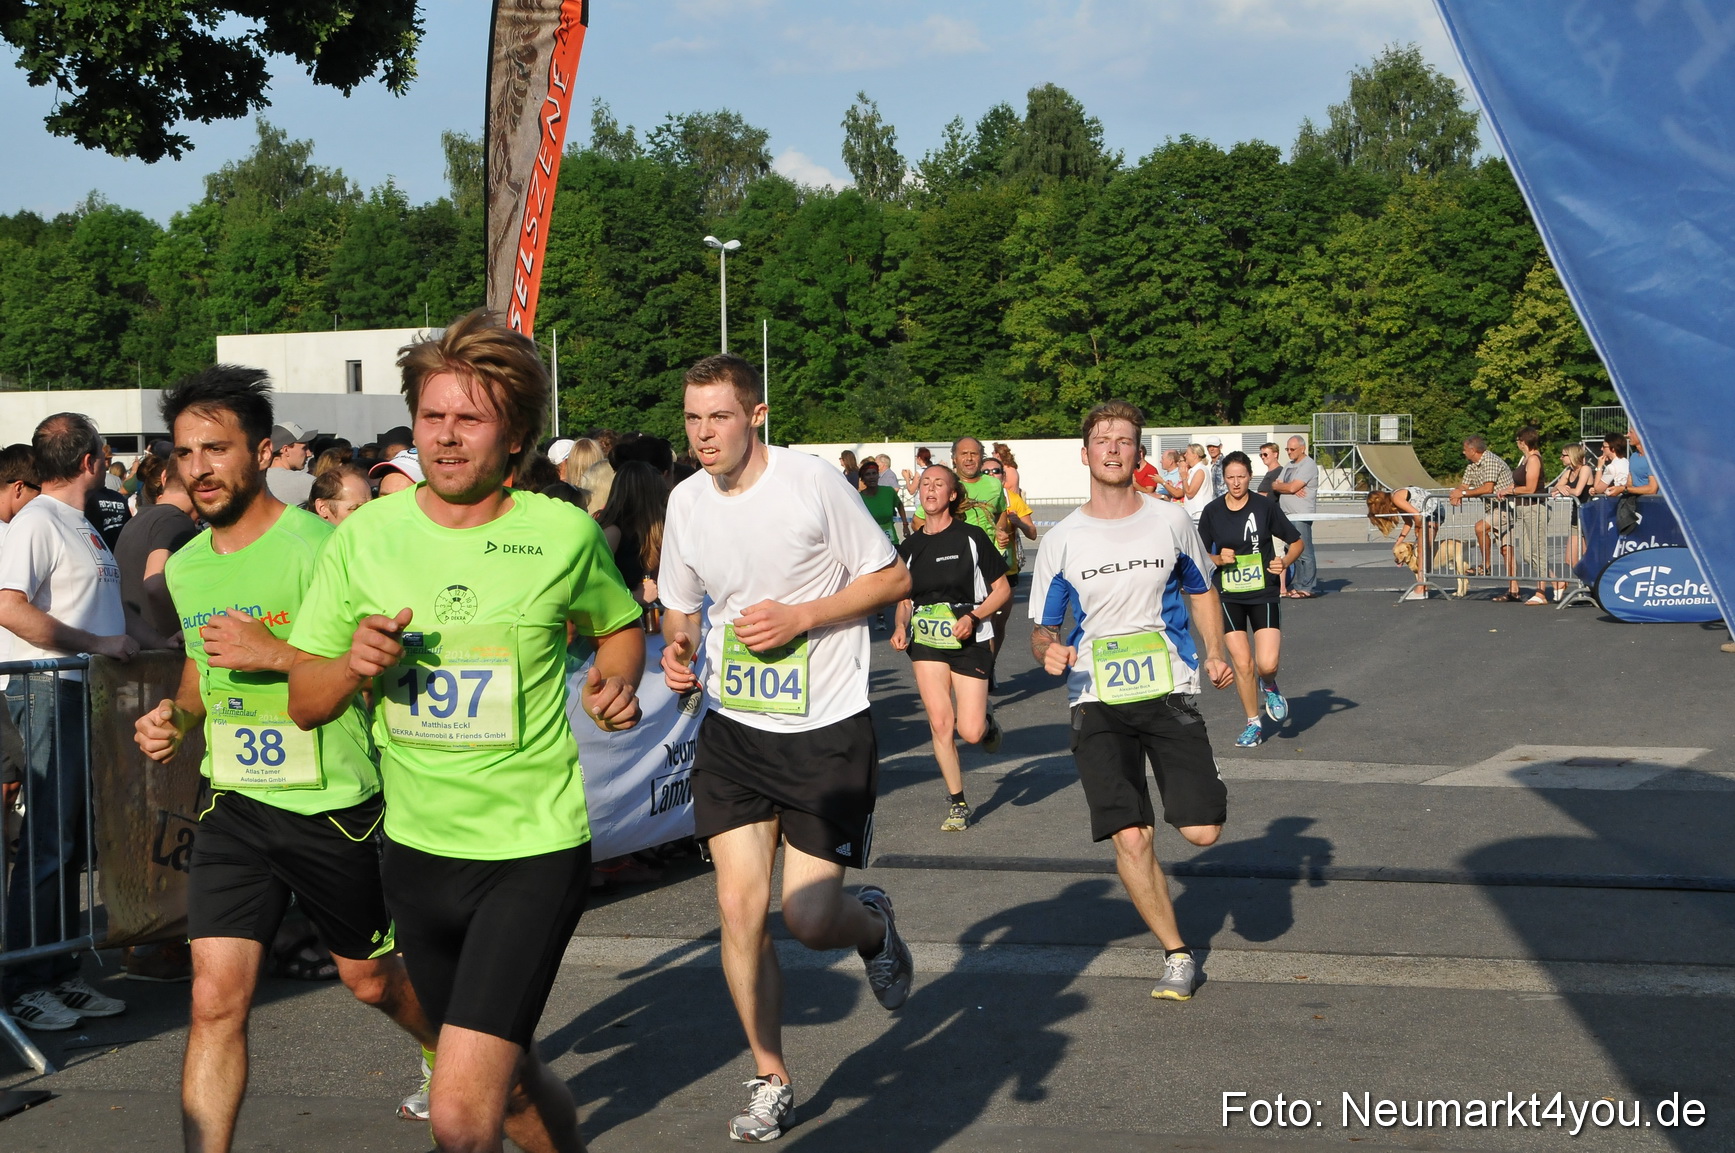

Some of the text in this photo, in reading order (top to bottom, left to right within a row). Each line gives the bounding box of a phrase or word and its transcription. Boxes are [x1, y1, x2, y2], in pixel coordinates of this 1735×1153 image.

[503, 544, 544, 556] DEKRA
[1081, 559, 1164, 580] DELPHI
[1223, 566, 1262, 583] 1054
[1634, 579, 1711, 598] Fische
[917, 618, 952, 638] 976
[725, 664, 802, 700] 5104
[1104, 655, 1156, 688] 201
[397, 668, 493, 719] 197
[391, 728, 414, 737] DEKRA
[415, 731, 447, 739] Automobil
[421, 720, 471, 729] Matthias Eckl
[234, 727, 287, 767] 38
[663, 738, 696, 769] Neum
[151, 809, 195, 874] La
